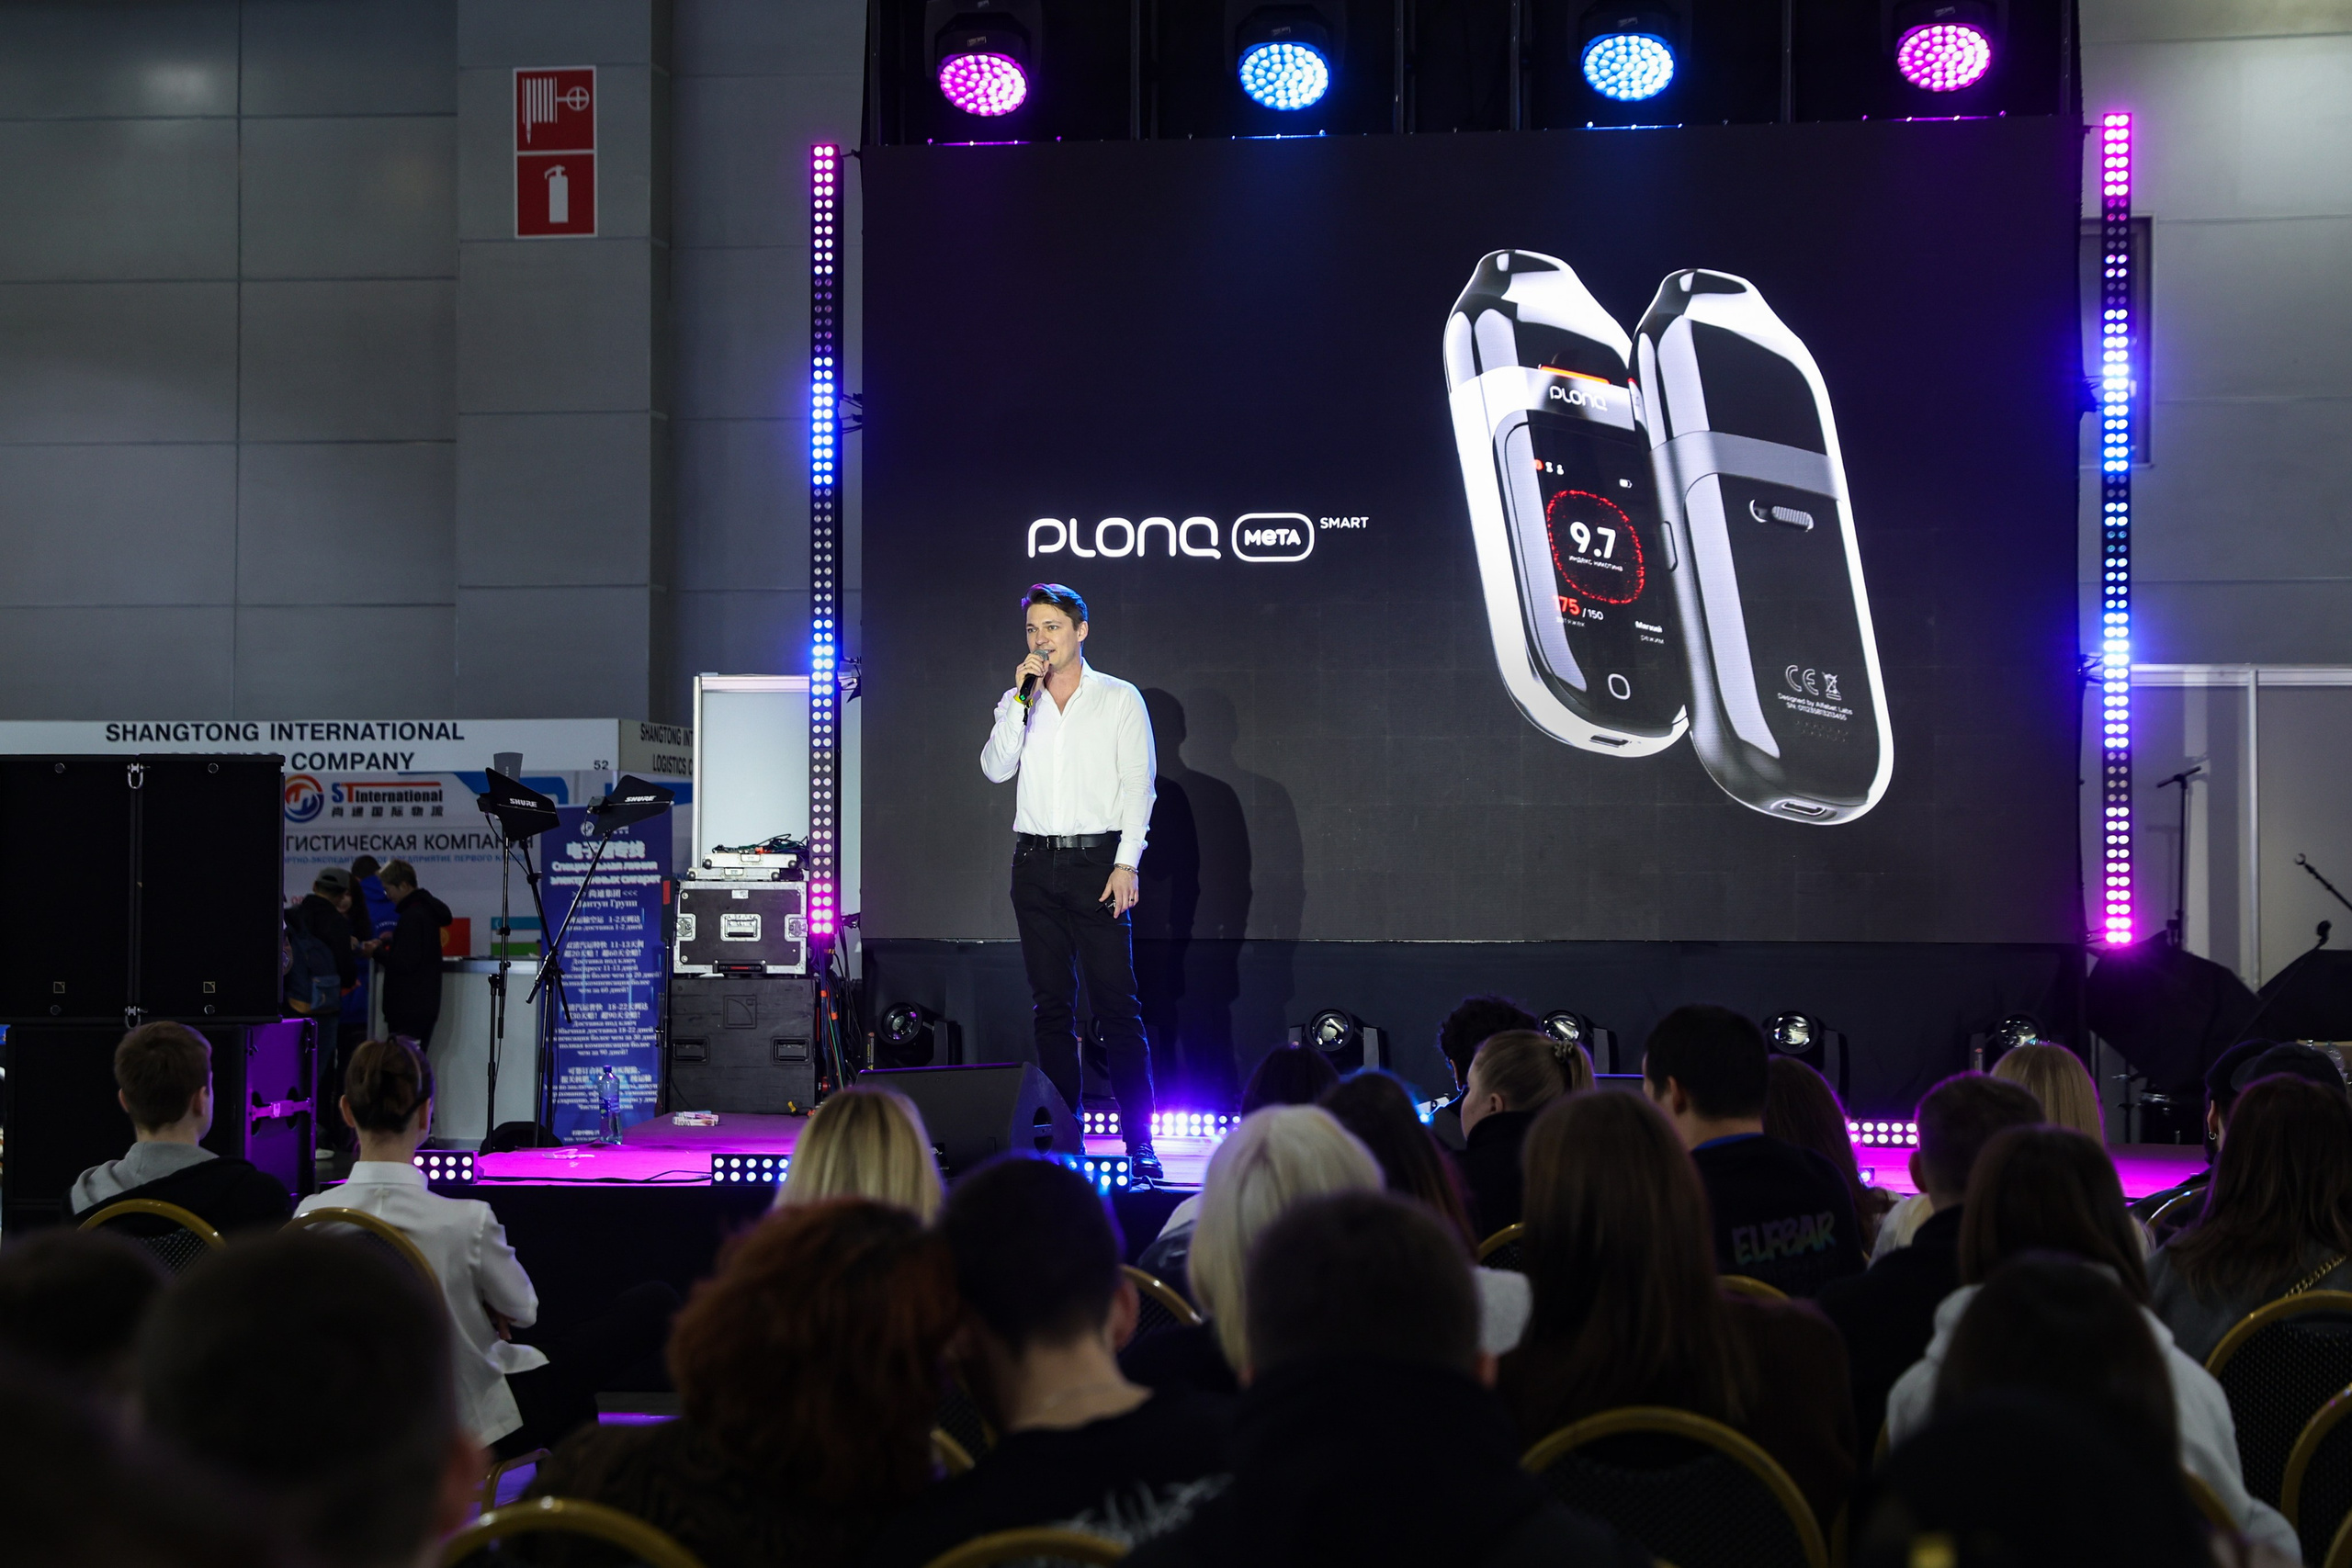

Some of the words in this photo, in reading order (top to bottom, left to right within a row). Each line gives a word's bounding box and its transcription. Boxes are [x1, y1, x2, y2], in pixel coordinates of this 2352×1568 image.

[1319, 516, 1370, 529] SMART
[1569, 521, 1616, 559] 9.7
[106, 723, 260, 741] SHANGTONG
[269, 722, 465, 741] INTERNATIONAL
[640, 723, 682, 746] SHANGTONG
[290, 751, 416, 771] COMPANY
[594, 760, 609, 770] 52
[653, 754, 687, 775] LOGISTICS
[509, 797, 538, 808] SHURE
[286, 834, 417, 851] ГИСТИЧЕСКАЯ
